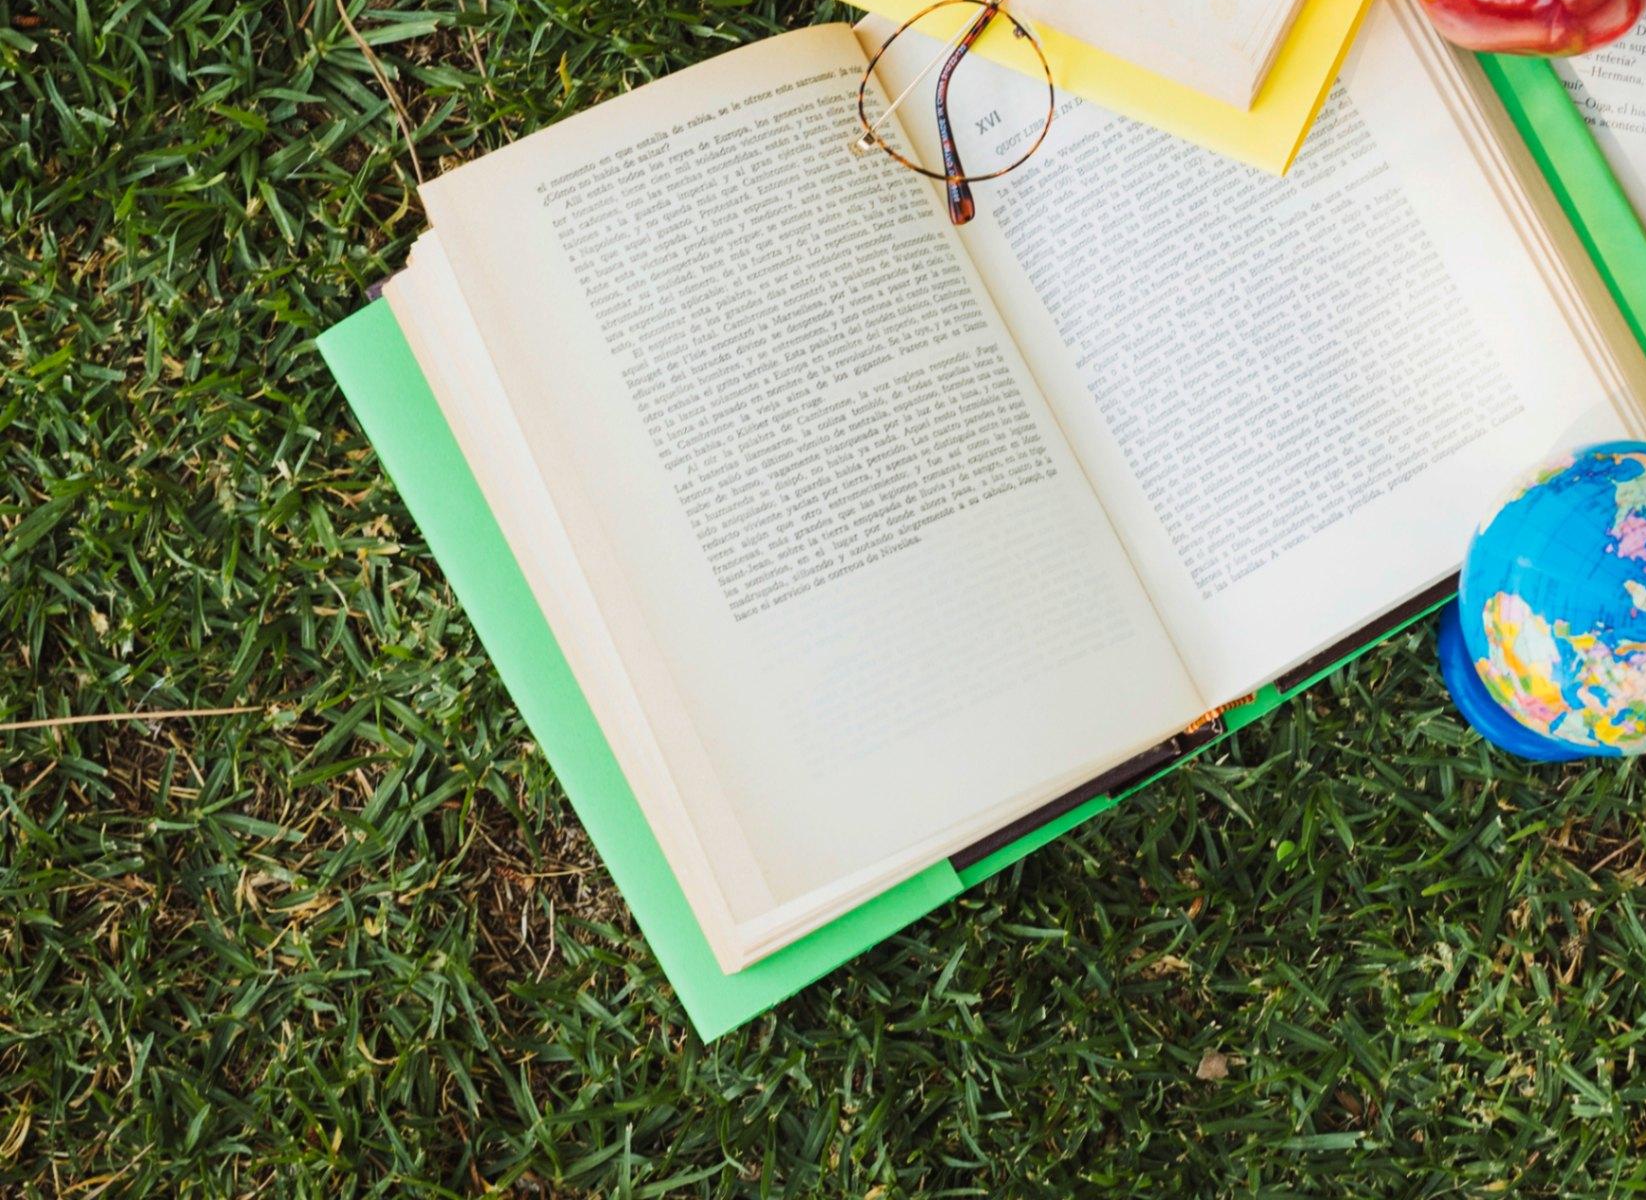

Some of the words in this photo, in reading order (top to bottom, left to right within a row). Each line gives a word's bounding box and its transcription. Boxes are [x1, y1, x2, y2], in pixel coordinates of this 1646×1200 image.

[974, 110, 1002, 135] XVI
[995, 133, 1021, 156] QUOT
[1023, 112, 1059, 138] LIBRS
[1061, 101, 1073, 115] IN
